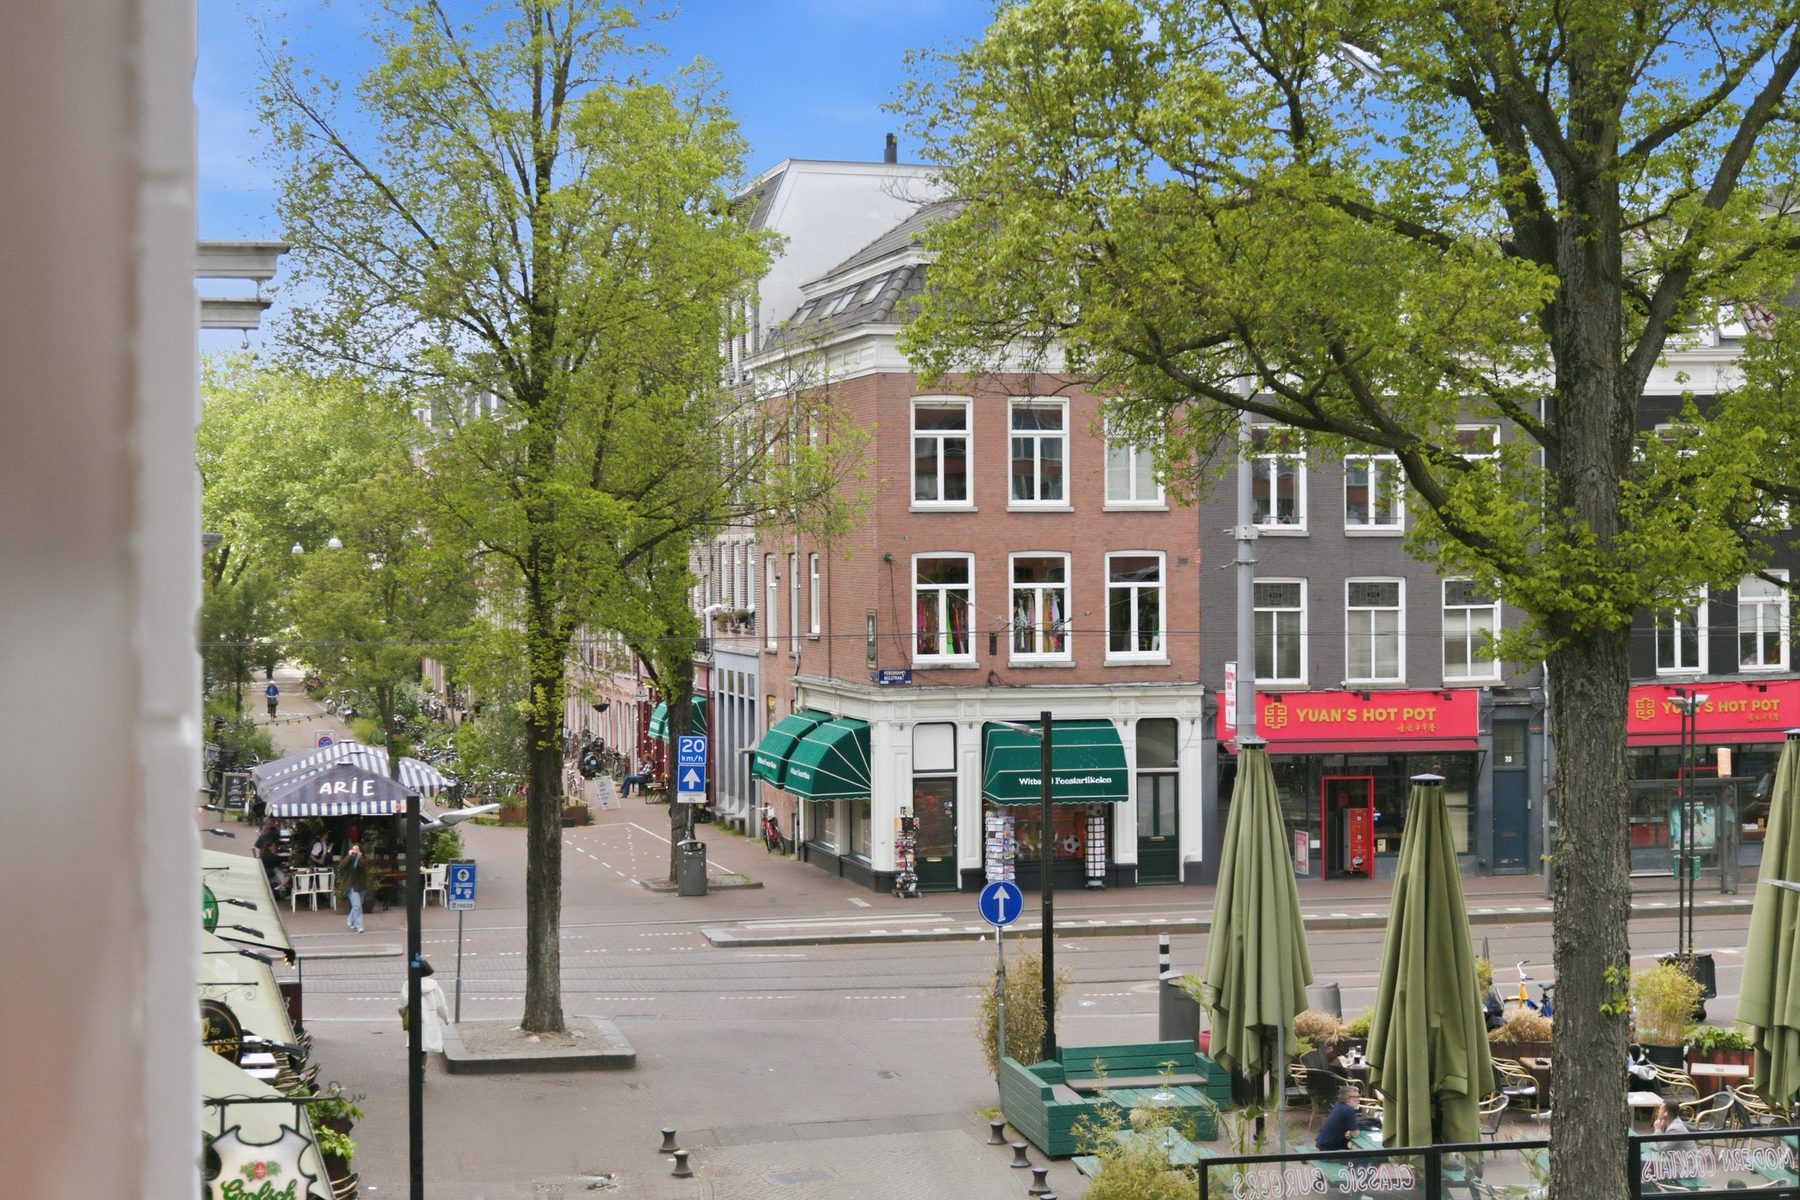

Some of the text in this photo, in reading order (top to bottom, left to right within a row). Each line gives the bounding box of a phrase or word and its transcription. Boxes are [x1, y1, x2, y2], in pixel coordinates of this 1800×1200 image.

[1718, 700, 1747, 713] HOT
[1751, 699, 1780, 712] POT
[1362, 707, 1398, 722] HOT
[1402, 707, 1437, 721] POT
[682, 739, 705, 753] 20
[1055, 776, 1112, 784] Feestartikelen
